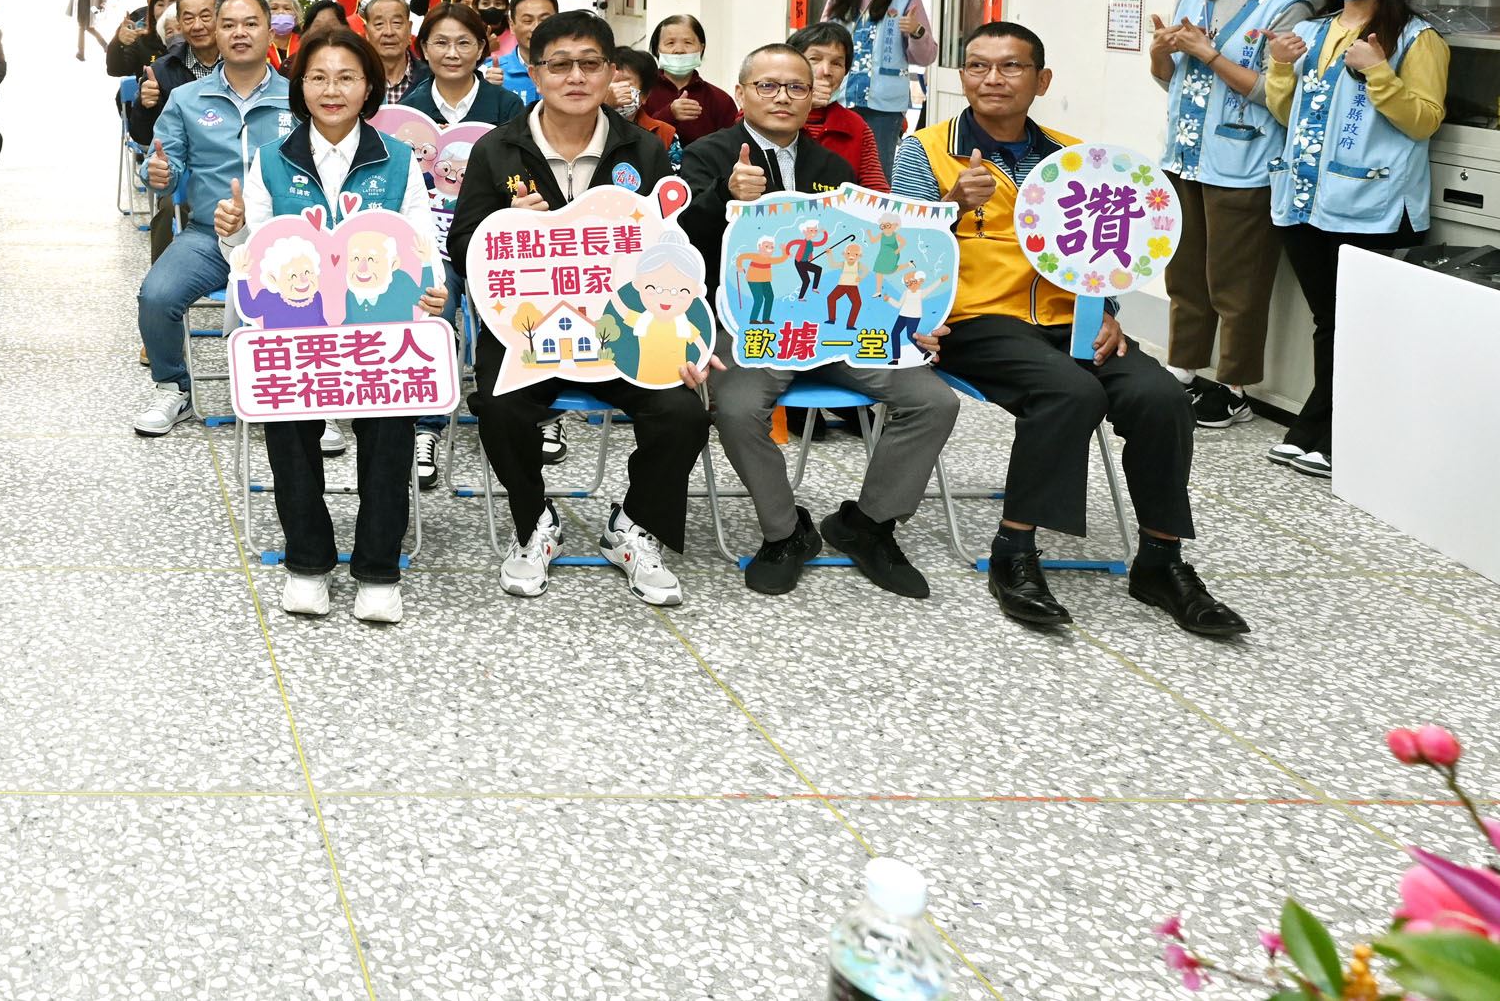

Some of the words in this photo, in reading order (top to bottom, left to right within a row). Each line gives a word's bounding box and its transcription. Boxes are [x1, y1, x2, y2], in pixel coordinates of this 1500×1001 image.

[484, 225, 643, 261] 據點是長輩
[1055, 180, 1146, 269] 讚
[488, 266, 613, 298] 第二個家
[248, 327, 435, 372] 苗栗老人
[743, 321, 889, 360] 歡據一堂
[251, 366, 438, 409] 幸福滿滿
